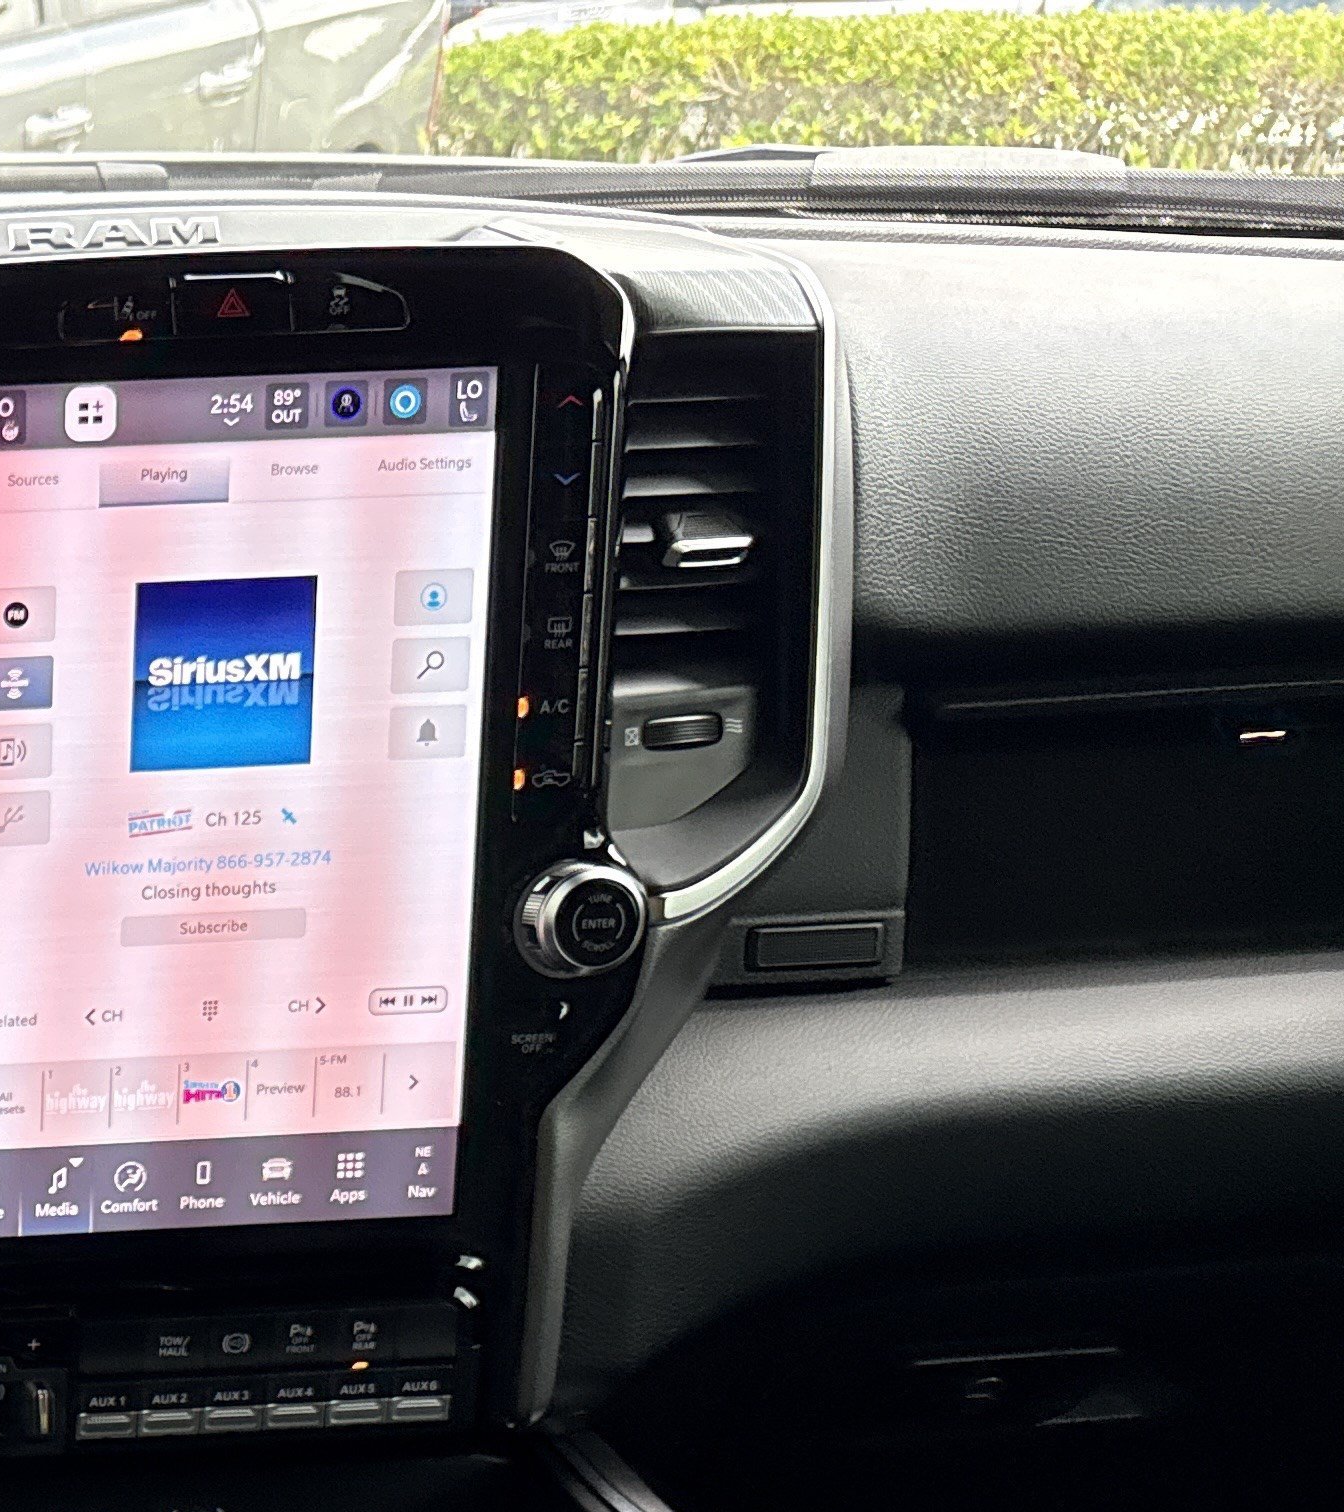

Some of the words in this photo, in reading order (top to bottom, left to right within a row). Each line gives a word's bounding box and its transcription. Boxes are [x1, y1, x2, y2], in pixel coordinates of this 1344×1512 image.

[8, 215, 221, 252] RAM
[136, 310, 158, 321] OFF
[328, 306, 350, 317] OFF
[455, 379, 483, 401] LO
[209, 393, 254, 416] 2:54
[271, 408, 303, 426] OUT
[270, 460, 320, 477] Browse
[377, 457, 416, 474] Audio
[419, 455, 472, 474] Settings
[7, 471, 60, 488] Sources
[140, 464, 189, 485] Playing
[544, 562, 580, 574] FRONT
[7, 608, 26, 622] FM
[544, 638, 573, 650] REAR
[147, 651, 301, 689] SiriusXM
[539, 700, 570, 714] A/C
[205, 812, 227, 828] Ch
[233, 810, 262, 826] 125
[84, 858, 144, 877] Wilkow
[146, 855, 213, 876] Majority
[216, 849, 332, 870] 866-957-2874
[141, 882, 202, 903] Closing
[205, 878, 277, 900] thoughts
[179, 918, 249, 936] Subscribe
[581, 918, 616, 930] ENTER
[288, 999, 310, 1014] CH
[101, 1009, 124, 1024] CH
[511, 1033, 554, 1045] SCREEN
[521, 1044, 542, 1054] OFF
[250, 1058, 258, 1068] 4
[319, 1054, 347, 1066] 5-FM
[114, 1066, 122, 1076] 2
[182, 1062, 190, 1073] 3
[256, 1082, 306, 1096] Preview
[334, 1085, 361, 1098] 88.1
[45, 1091, 108, 1115] highway
[113, 1088, 177, 1113] highway
[414, 1145, 432, 1159] NE
[249, 1189, 302, 1207] Vehicle
[329, 1187, 366, 1205] Apps
[407, 1184, 436, 1200] Nav
[35, 1200, 79, 1219] Media
[100, 1196, 159, 1216] Comfort
[179, 1194, 225, 1211] Phone
[355, 1333, 373, 1342] OFF
[158, 1347, 189, 1358] HAUL
[285, 1344, 316, 1354] FRONT
[277, 1387, 303, 1398] AUX
[339, 1384, 366, 1395] AUX
[401, 1381, 428, 1392] AUX
[88, 1396, 115, 1408] AUX
[151, 1394, 179, 1405] AUX
[213, 1391, 241, 1402] AUX
